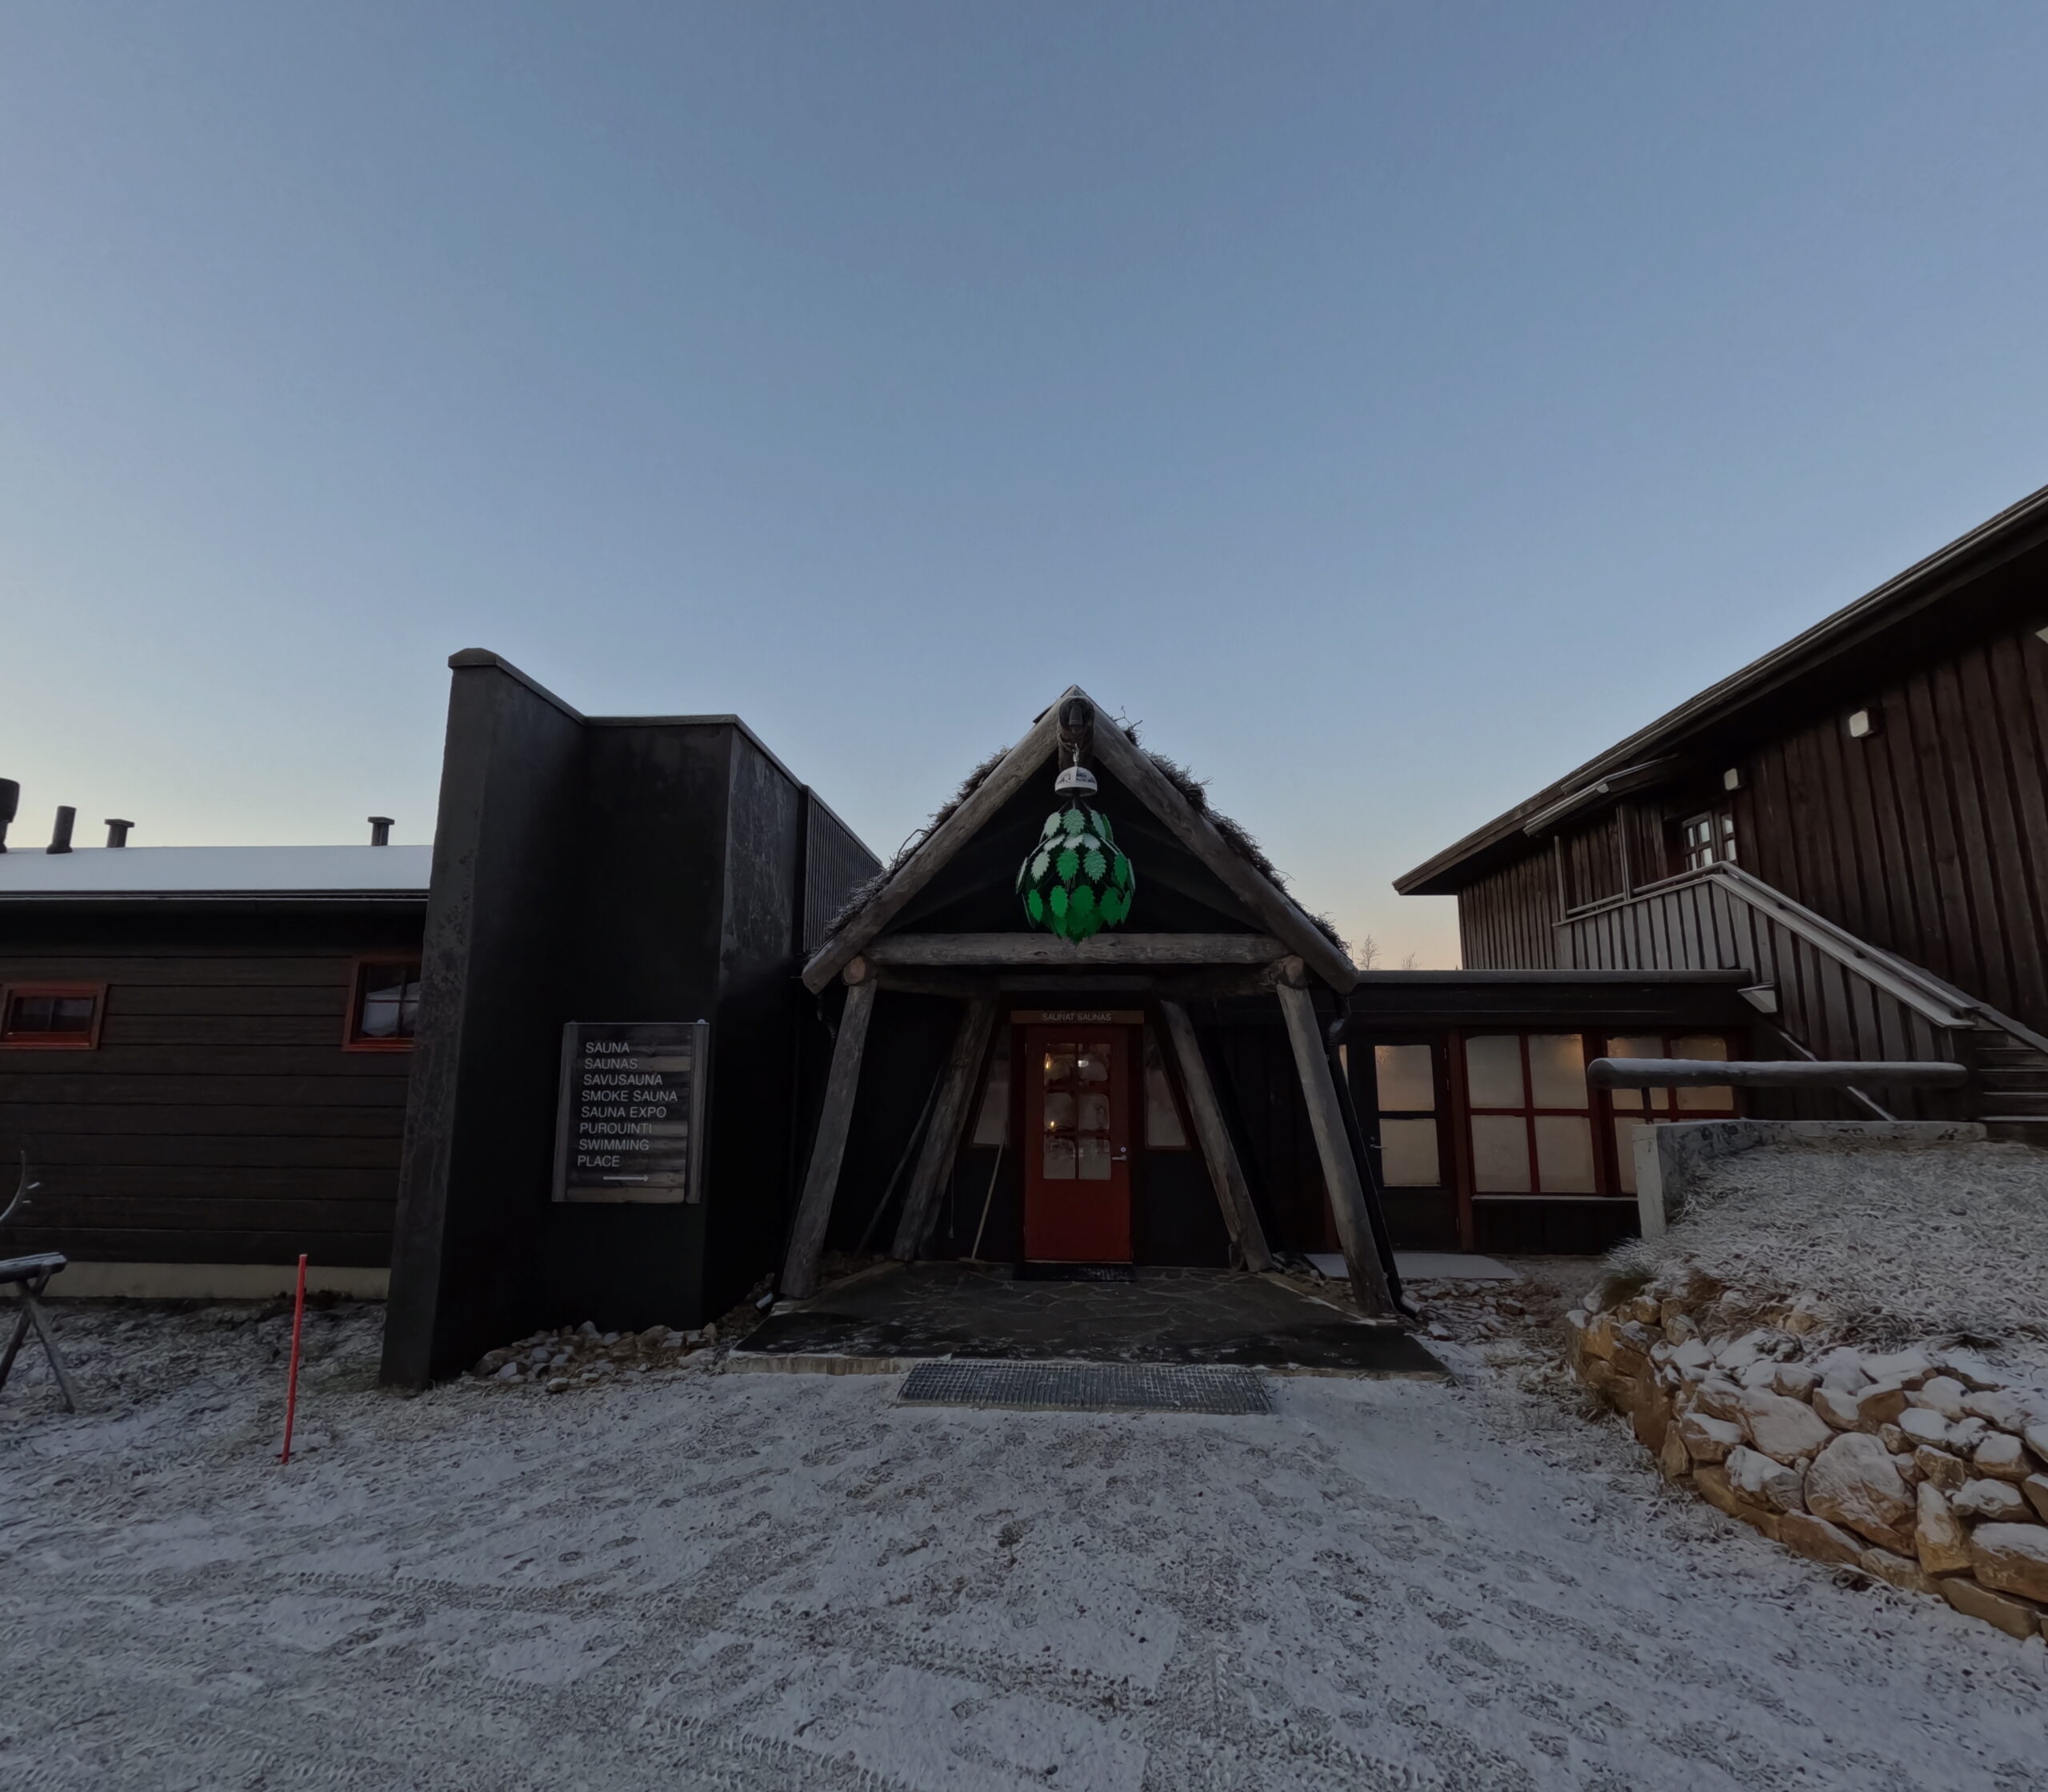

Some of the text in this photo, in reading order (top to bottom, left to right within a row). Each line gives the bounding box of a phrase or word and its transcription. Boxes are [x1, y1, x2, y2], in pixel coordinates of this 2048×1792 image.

[1042, 1013, 1112, 1021] SAUNAT SAUNAS
[586, 1042, 630, 1054] SAUNA
[584, 1058, 638, 1070] SAUNAS
[583, 1074, 663, 1086] SAVUSAUNA
[582, 1090, 678, 1102] SMOKE SAUNA
[581, 1106, 666, 1118] SAUNA EXPO
[579, 1123, 652, 1134] PUROUINTI
[578, 1139, 650, 1150] SWIMMING
[578, 1155, 621, 1166] PLACE
